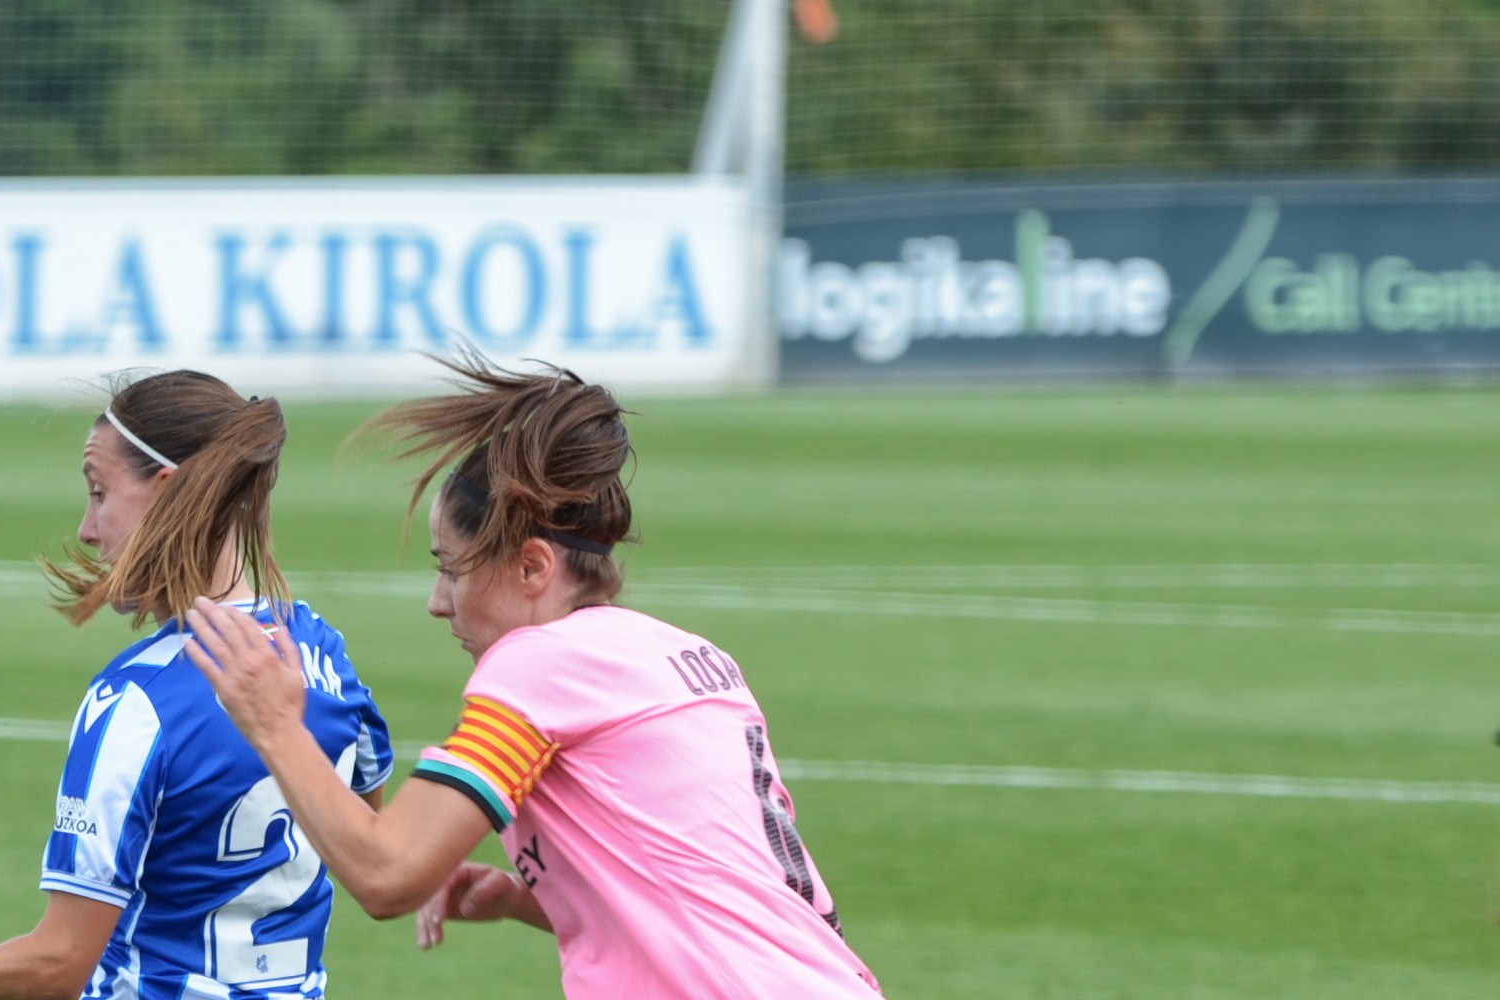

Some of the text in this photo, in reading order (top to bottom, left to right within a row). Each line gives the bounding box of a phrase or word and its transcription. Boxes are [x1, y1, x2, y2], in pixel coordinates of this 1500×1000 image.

[208, 224, 716, 352] KIROLA
[777, 210, 1171, 363] logikaline
[1246, 253, 1360, 334] Call
